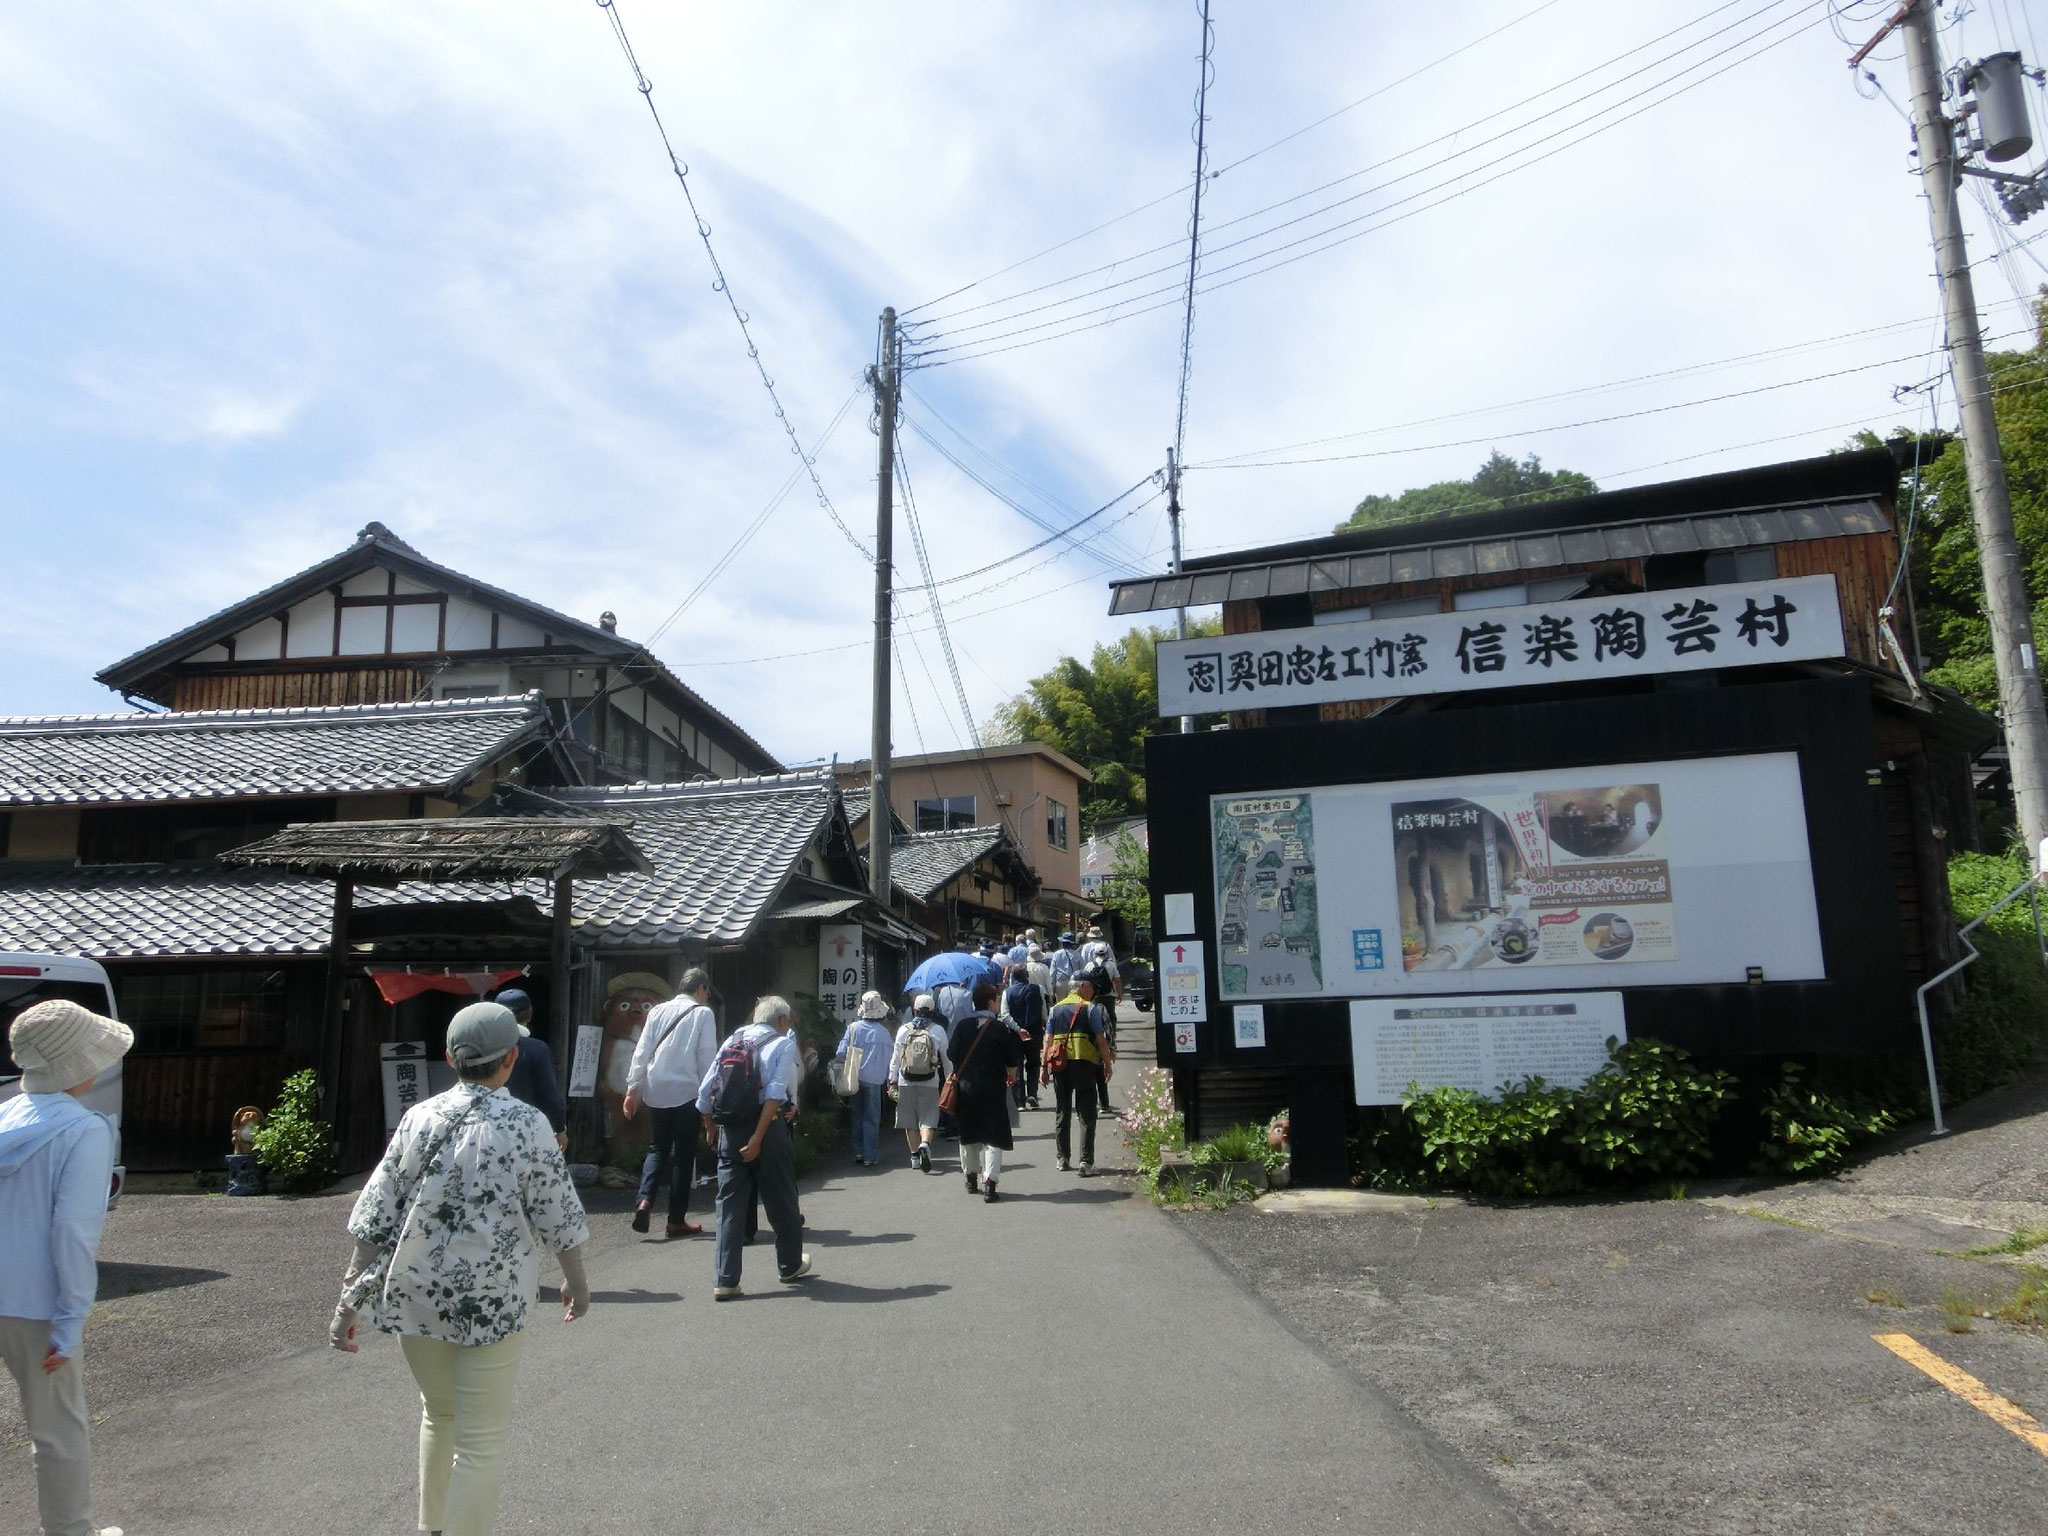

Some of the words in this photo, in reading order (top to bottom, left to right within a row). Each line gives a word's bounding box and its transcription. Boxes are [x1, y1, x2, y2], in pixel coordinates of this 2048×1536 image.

[1455, 594, 1797, 675] 信楽陶芸村
[1397, 809, 1479, 830] 信楽陶芸村
[842, 967, 859, 1024] のぼ
[1167, 995, 1199, 1005] 売店は
[1170, 1005, 1198, 1015] この上
